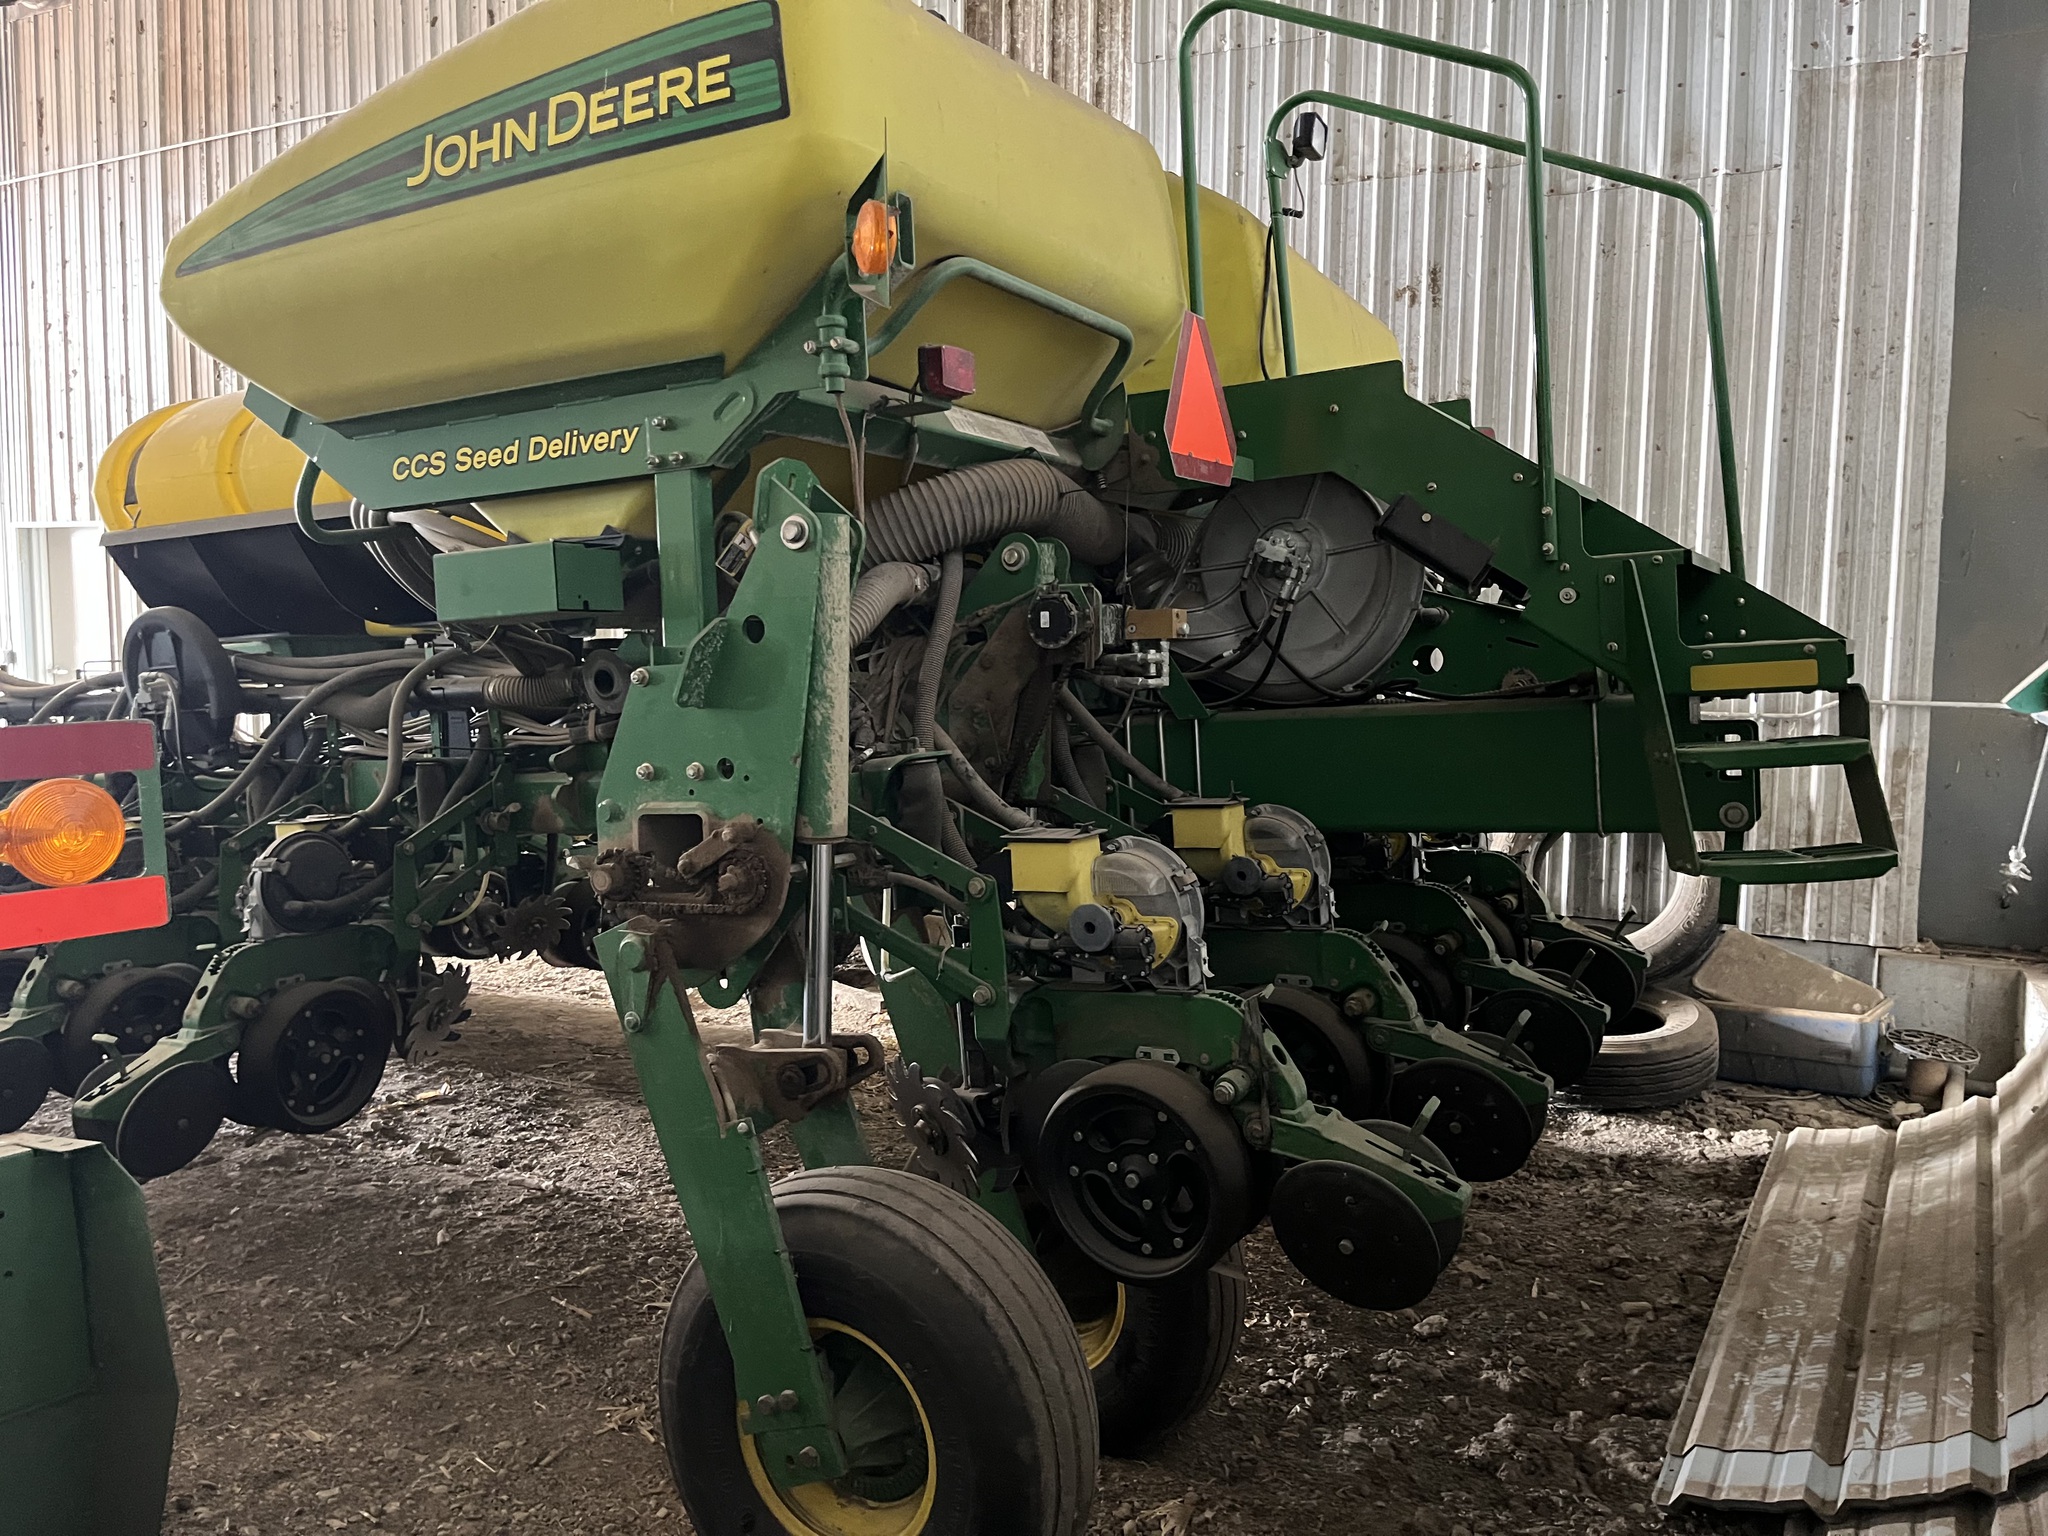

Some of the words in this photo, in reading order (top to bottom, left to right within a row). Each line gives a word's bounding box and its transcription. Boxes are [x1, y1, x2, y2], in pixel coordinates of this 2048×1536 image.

[406, 111, 537, 187] JOHN
[548, 54, 731, 146] DEERE
[392, 450, 447, 481] CCS
[454, 439, 520, 472] Seed
[527, 426, 640, 462] Delivery
